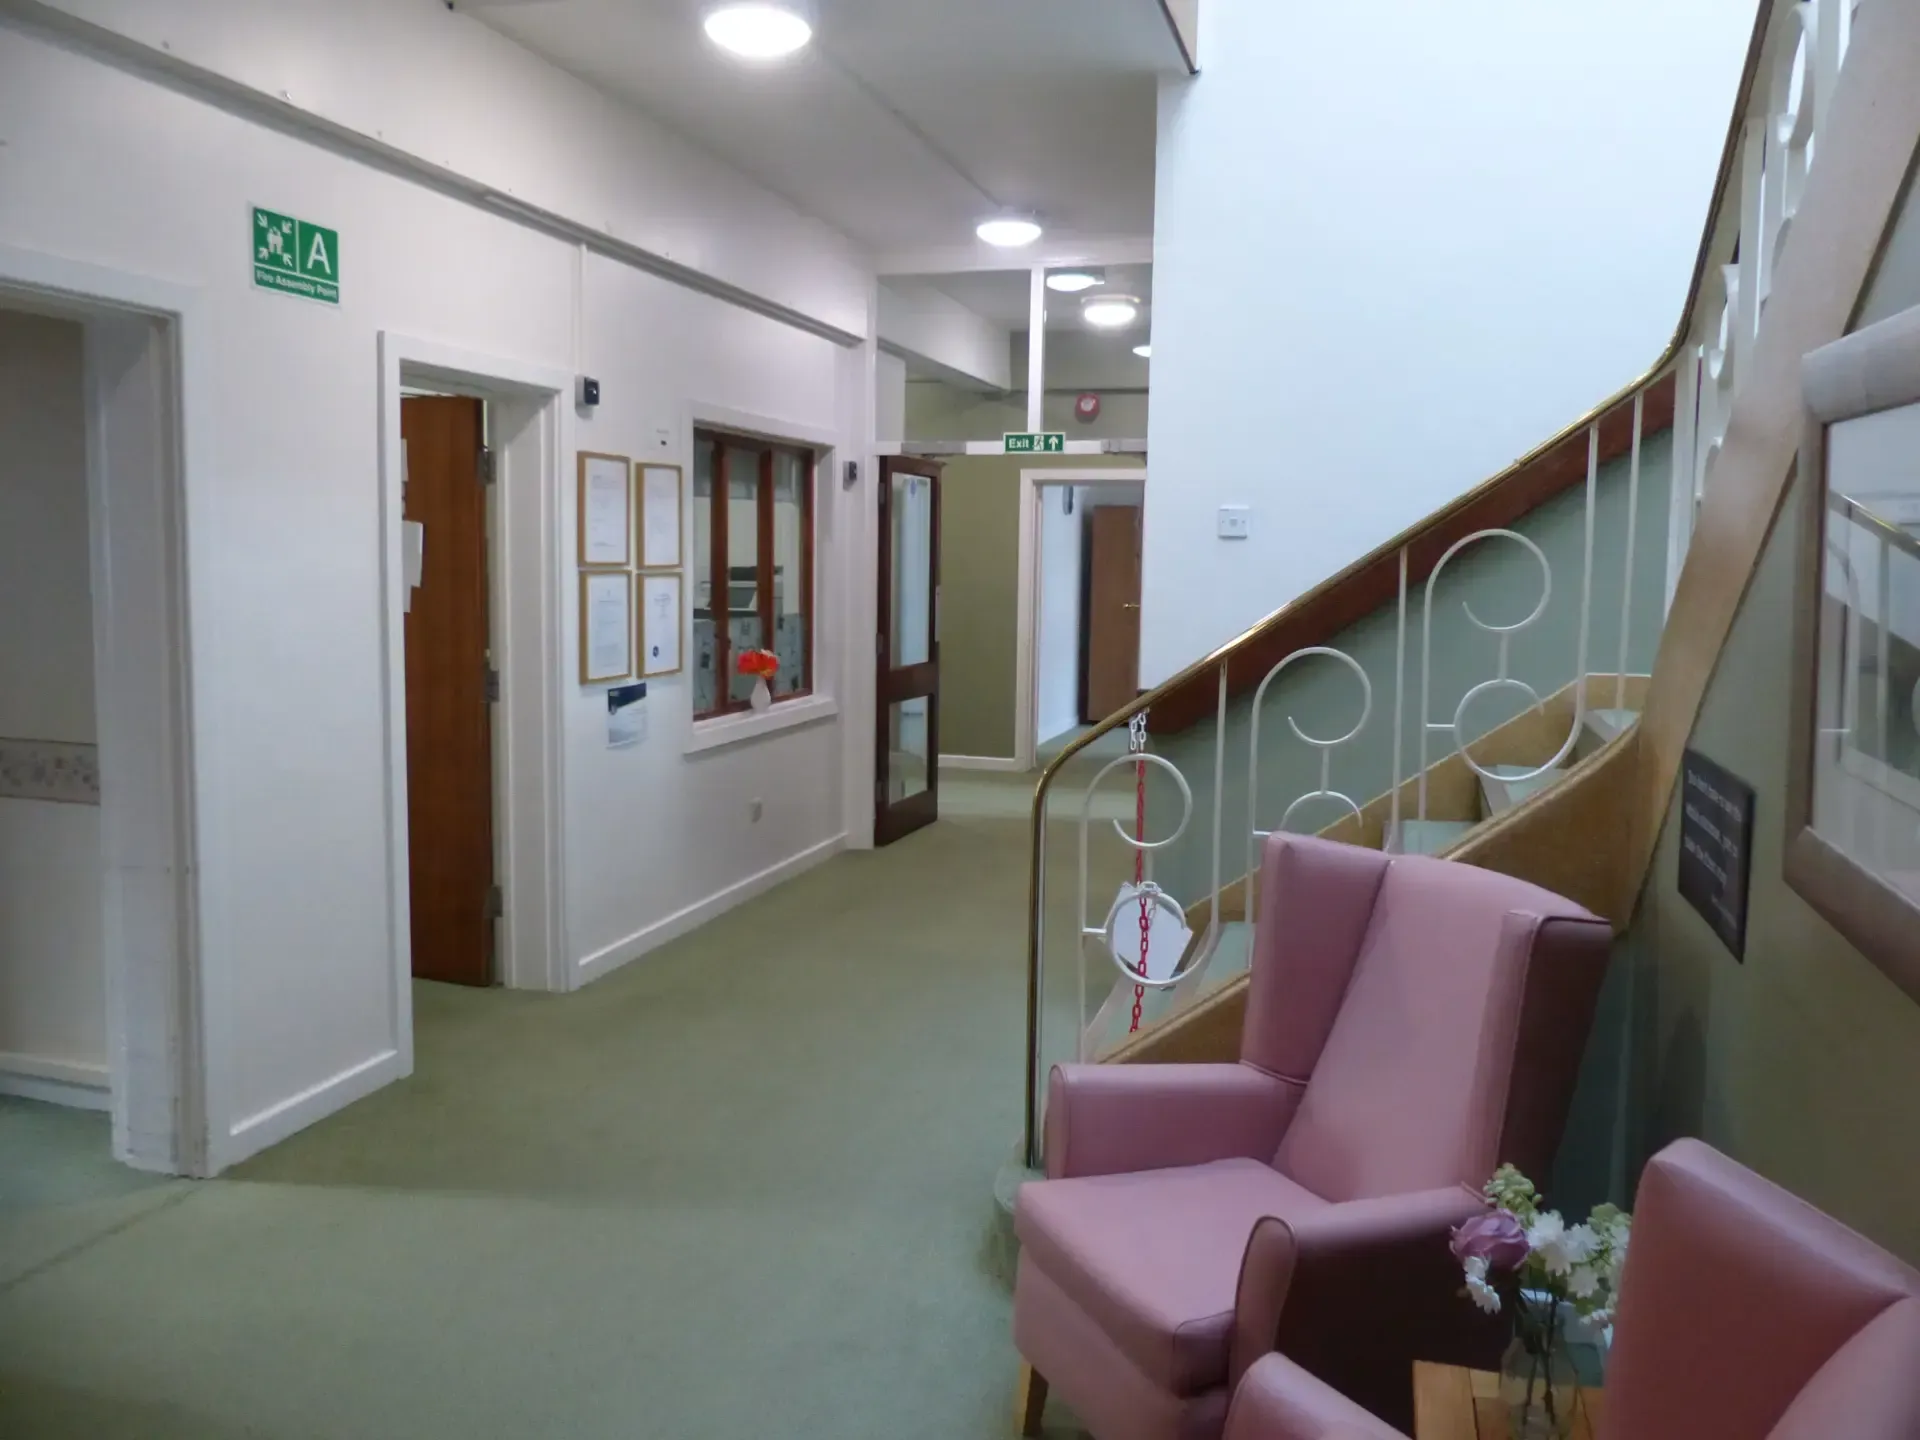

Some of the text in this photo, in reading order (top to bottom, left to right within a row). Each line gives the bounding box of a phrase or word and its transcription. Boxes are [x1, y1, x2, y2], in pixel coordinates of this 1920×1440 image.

[307, 232, 331, 275] A
[256, 270, 274, 282] Fire
[276, 275, 316, 294] Assembly
[1008, 438, 1029, 449] Exit
